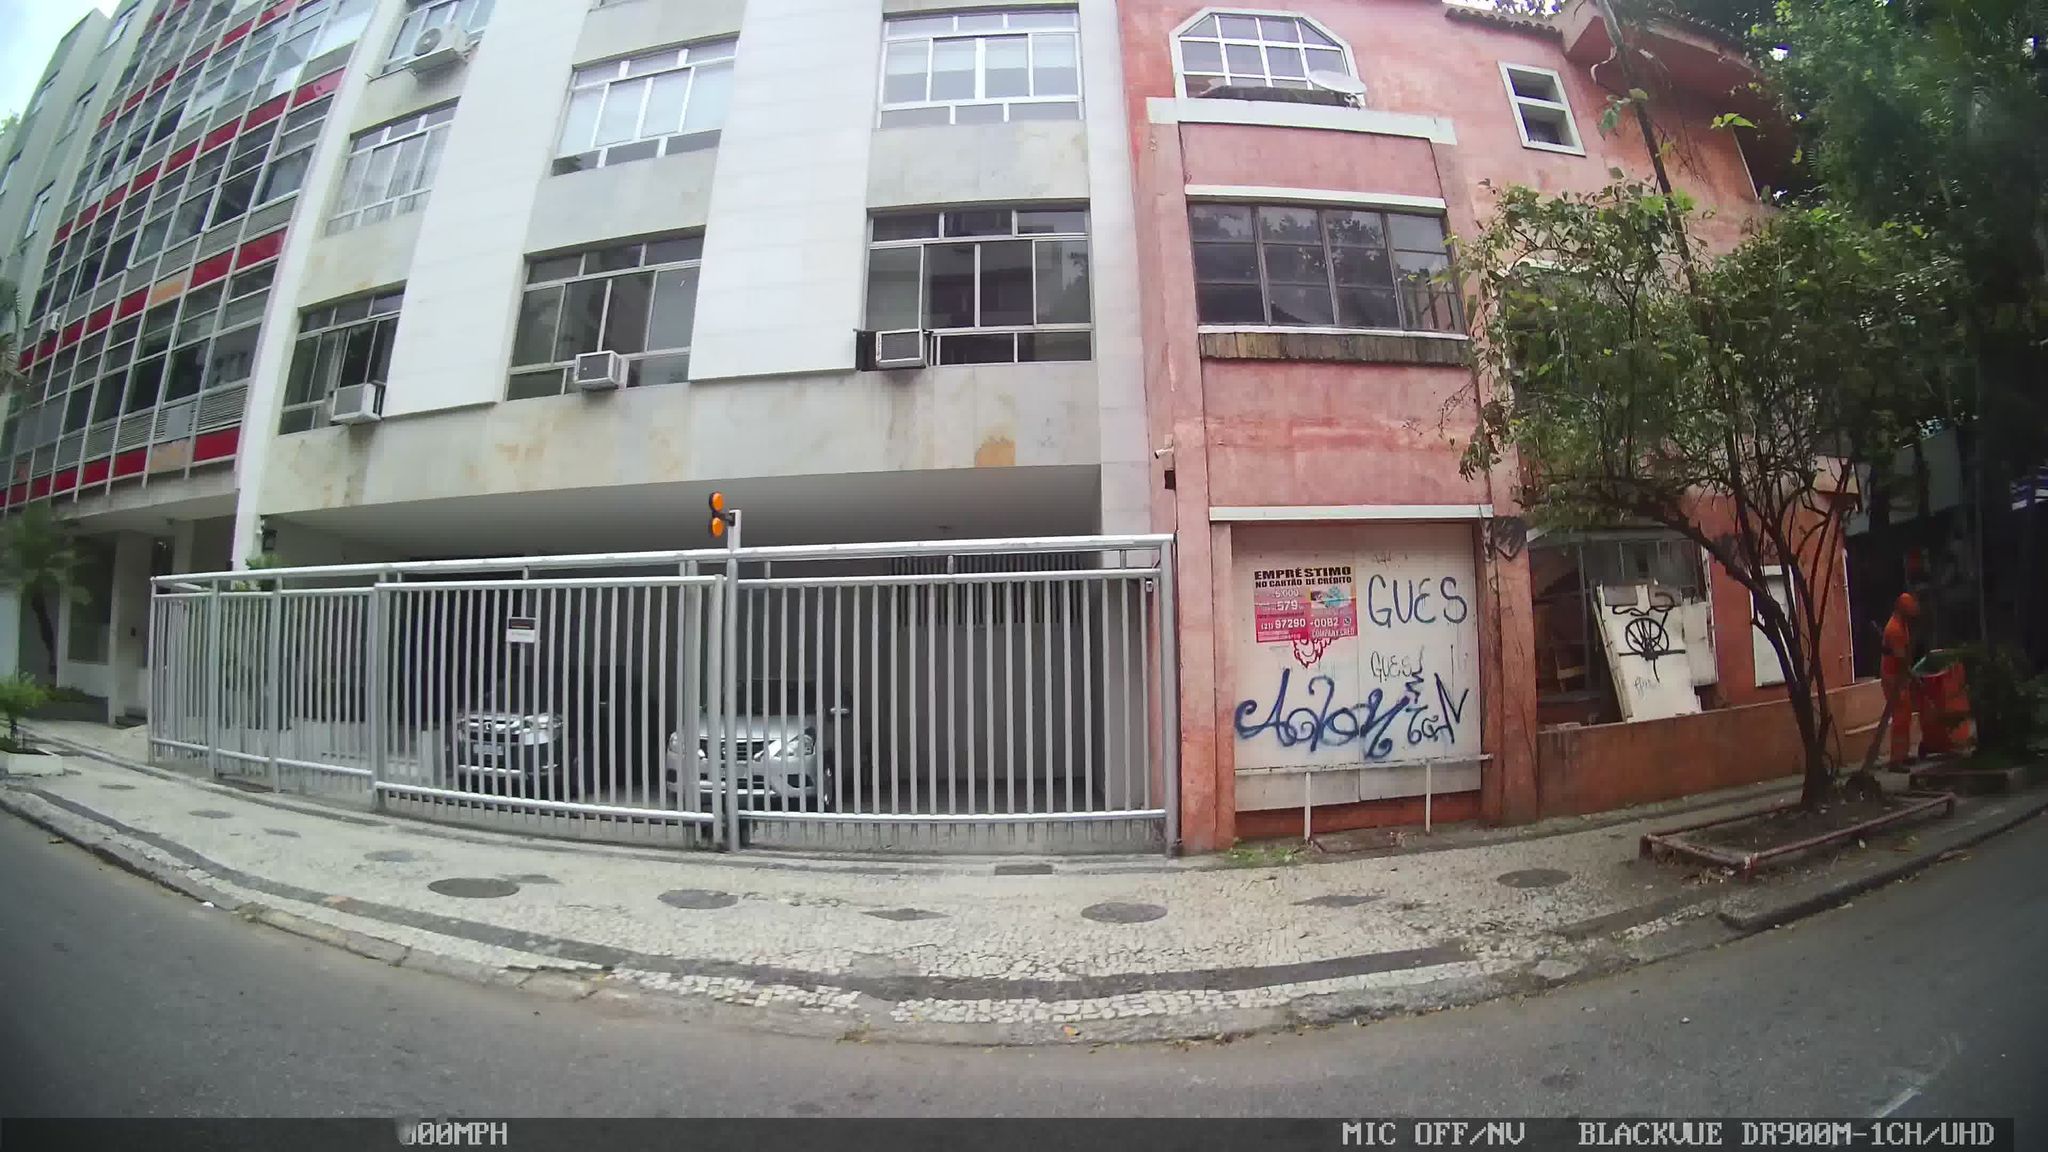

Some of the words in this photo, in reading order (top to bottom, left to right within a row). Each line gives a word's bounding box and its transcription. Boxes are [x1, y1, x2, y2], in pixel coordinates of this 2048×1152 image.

[1254, 566, 1352, 580] EMPRÉSTIMO
[1255, 580, 1267, 588] NO
[1269, 578, 1303, 588] CARTÃO
[1305, 577, 1316, 586] DE
[1317, 575, 1352, 585] CRÉDITO
[1276, 599, 1298, 611] 579
[1368, 574, 1467, 628] GUES
[1275, 618, 1306, 630] 97290
